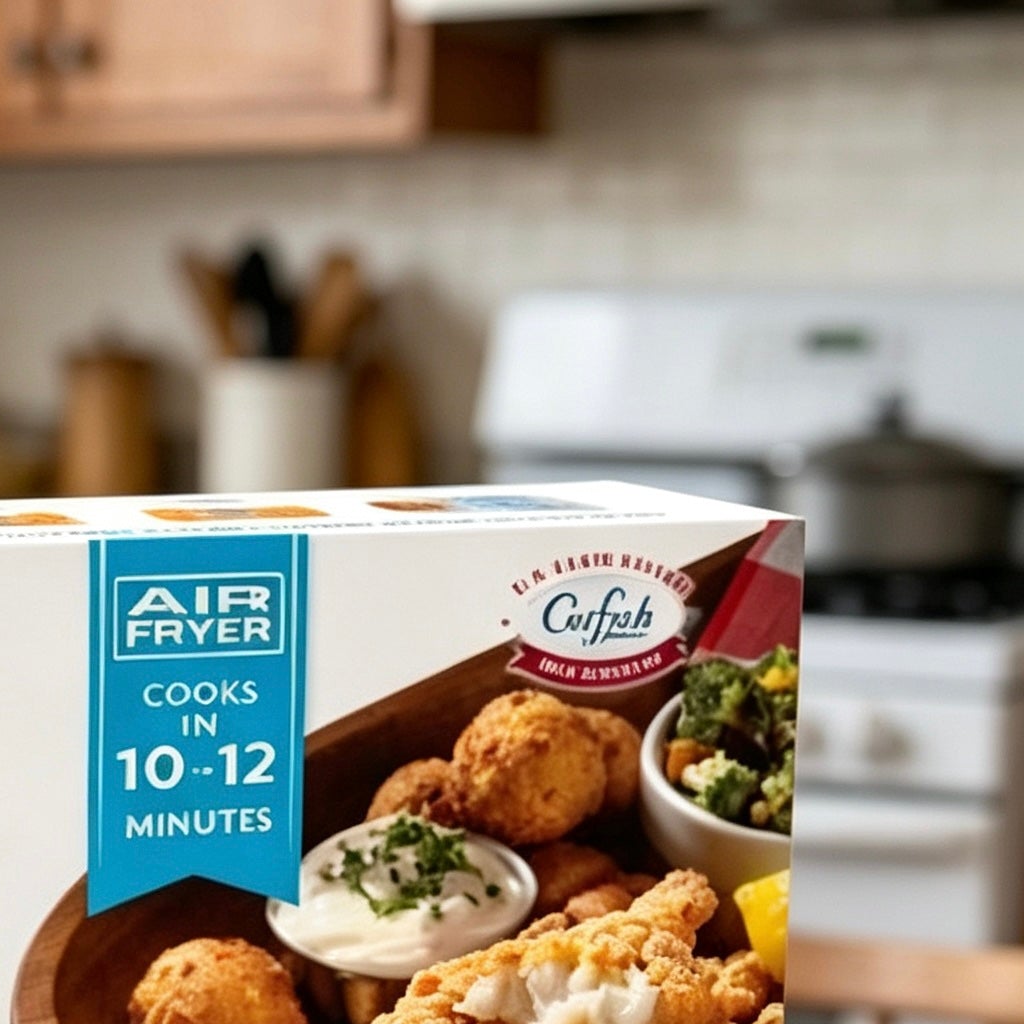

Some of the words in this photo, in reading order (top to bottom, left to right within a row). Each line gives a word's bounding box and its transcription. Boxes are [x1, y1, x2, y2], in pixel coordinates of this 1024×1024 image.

[128, 586, 270, 616] AIR
[127, 614, 270, 647] FRYER
[144, 681, 257, 706] COOKS
[183, 714, 216, 736] IN
[126, 807, 271, 838] MINUTES
